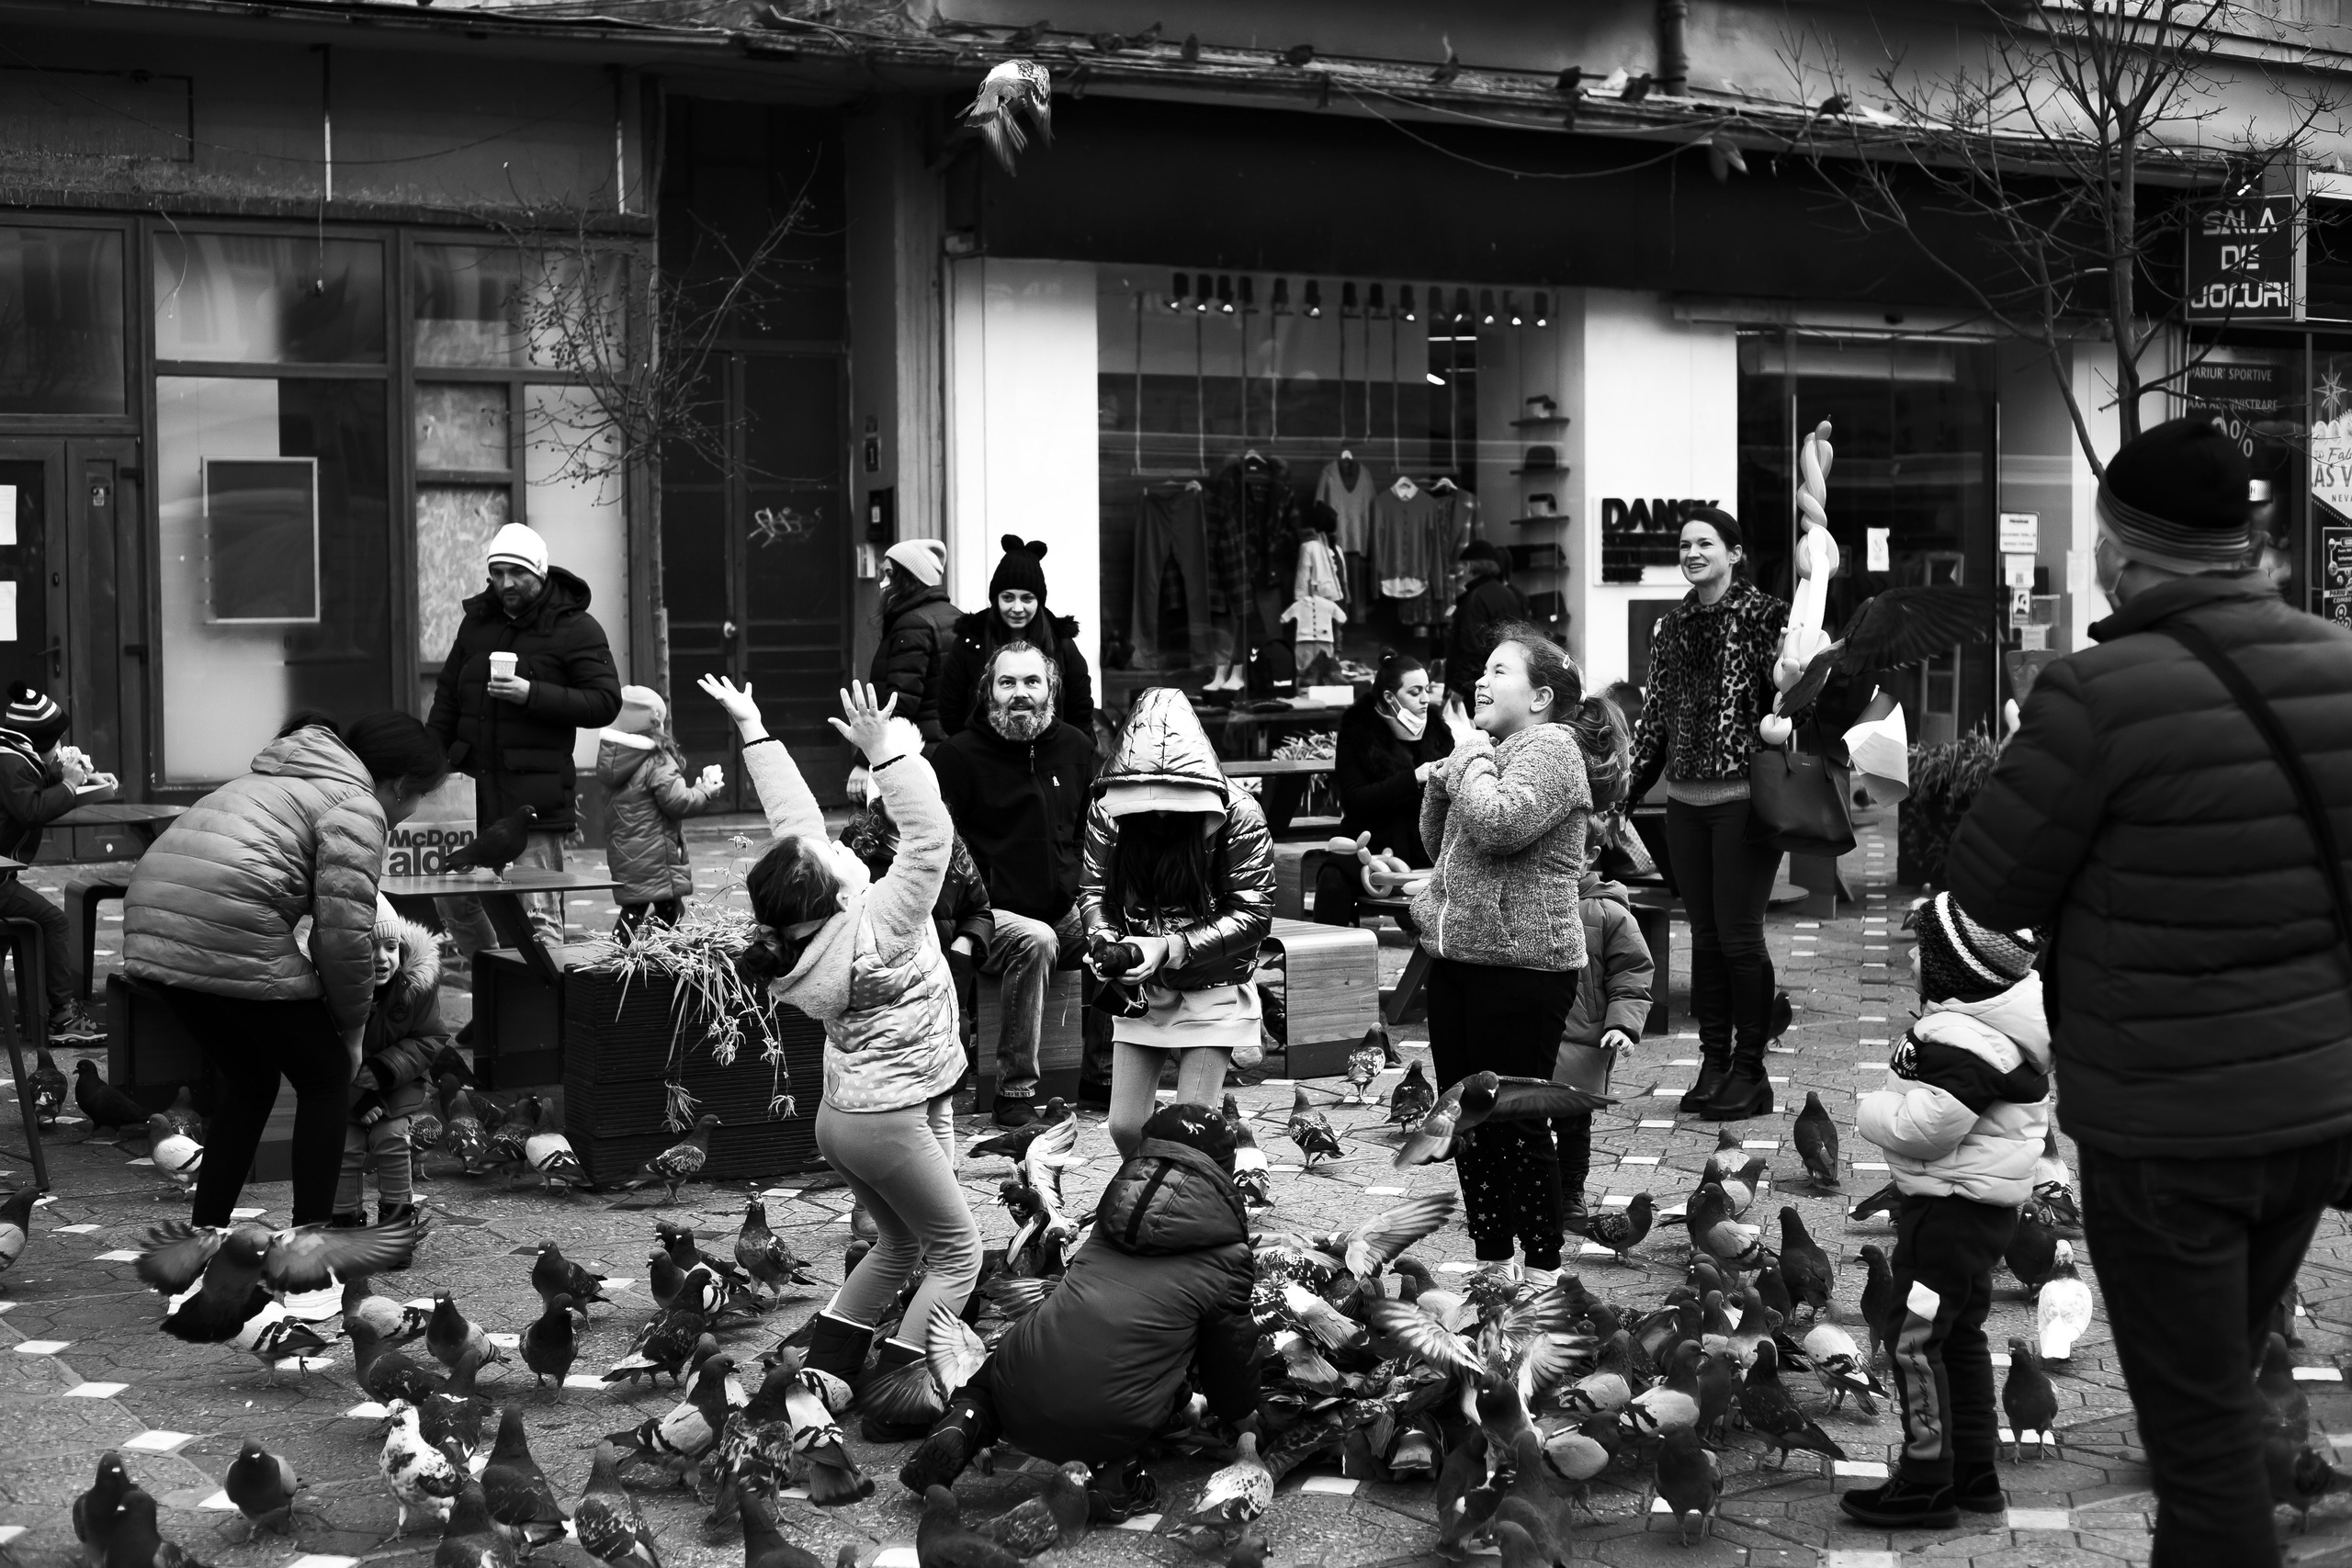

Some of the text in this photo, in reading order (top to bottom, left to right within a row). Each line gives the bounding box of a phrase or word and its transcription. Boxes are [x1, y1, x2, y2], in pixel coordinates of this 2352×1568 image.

[2202, 208, 2278, 235] SALA
[2221, 244, 2260, 270] DE
[2190, 282, 2290, 309] JOCURI
[2229, 367, 2272, 382] SPORTIVE
[2312, 464, 2335, 488] AS
[388, 829, 475, 848] McDon
